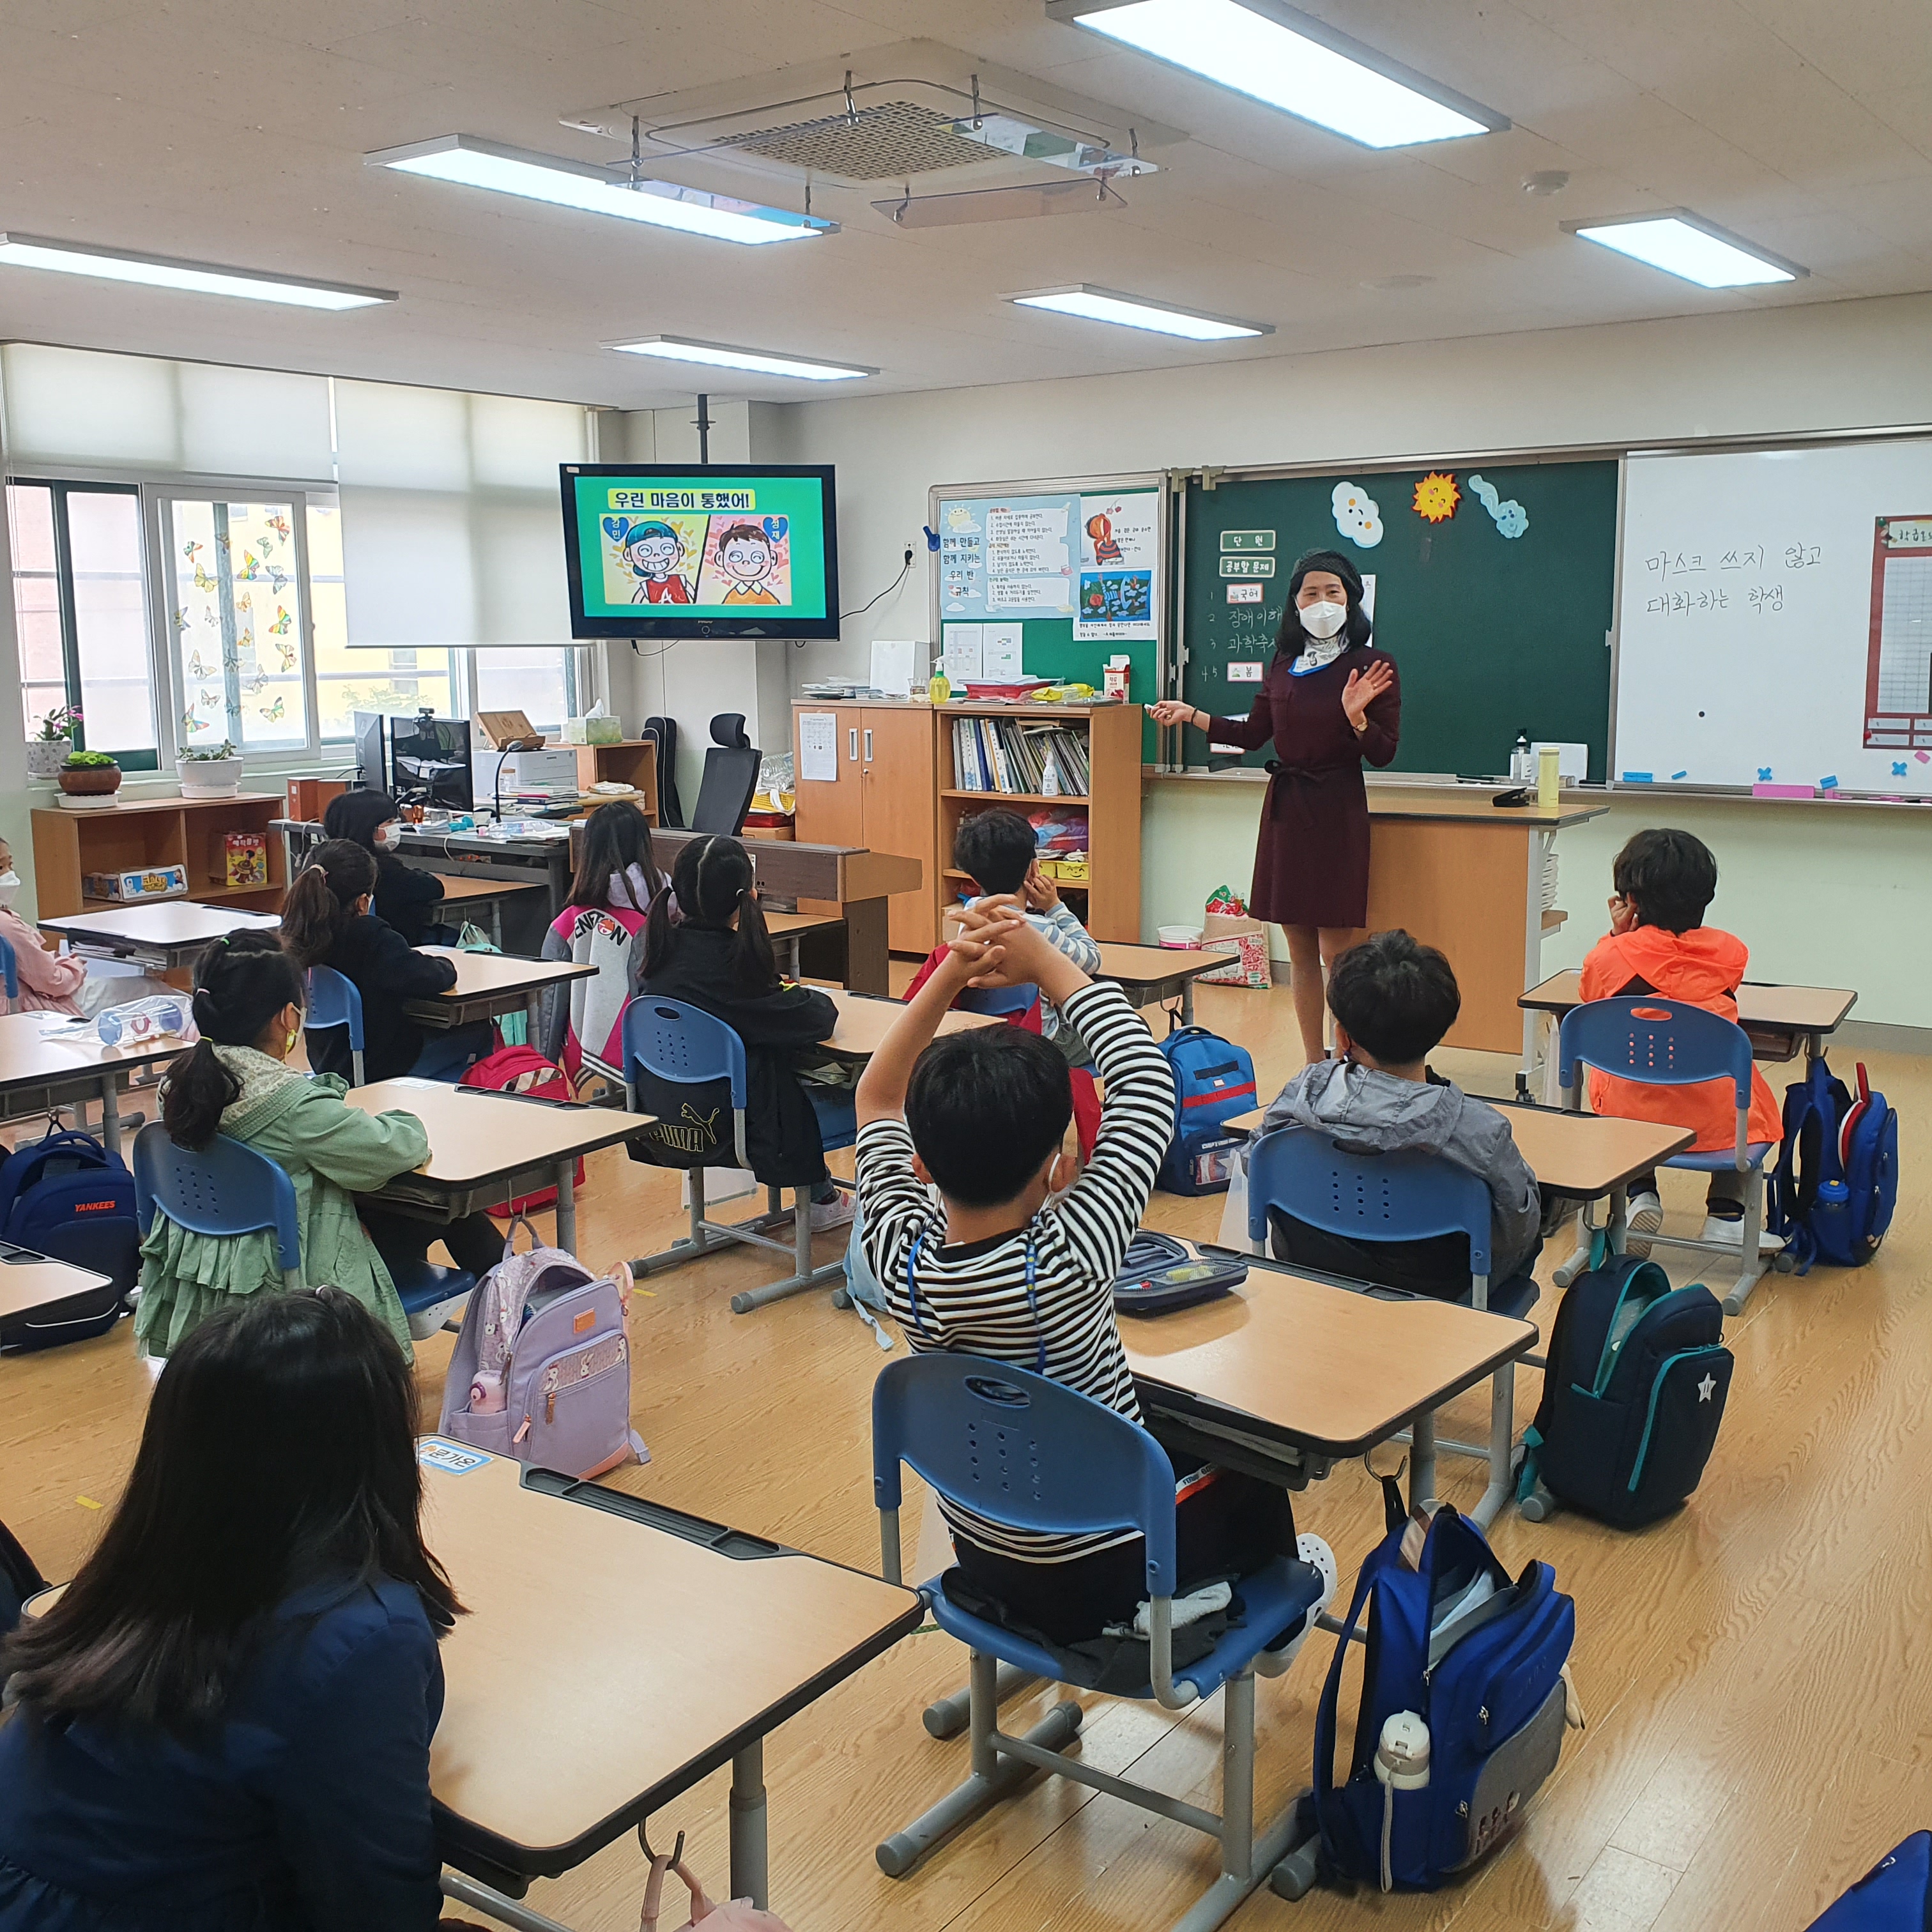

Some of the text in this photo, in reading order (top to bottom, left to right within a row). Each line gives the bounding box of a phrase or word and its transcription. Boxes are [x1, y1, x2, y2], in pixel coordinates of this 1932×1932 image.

[615, 493, 749, 508] 우린 마음이 통했어!
[942, 537, 980, 548] 함께 만들고
[1234, 535, 1263, 547] 단 원
[943, 553, 981, 565] 함께 지키는
[1644, 542, 1821, 582] 마스크 쓰지 않고
[1225, 560, 1269, 574] 공부할 문제
[948, 570, 974, 581] 우리 반
[955, 586, 969, 597] 규칙
[1241, 588, 1259, 601] 국어
[1646, 584, 1784, 617] 대화하는 학생
[1245, 666, 1254, 678] 봄
[75, 1200, 116, 1212] YANKEES
[429, 1448, 476, 1468] 문가온
